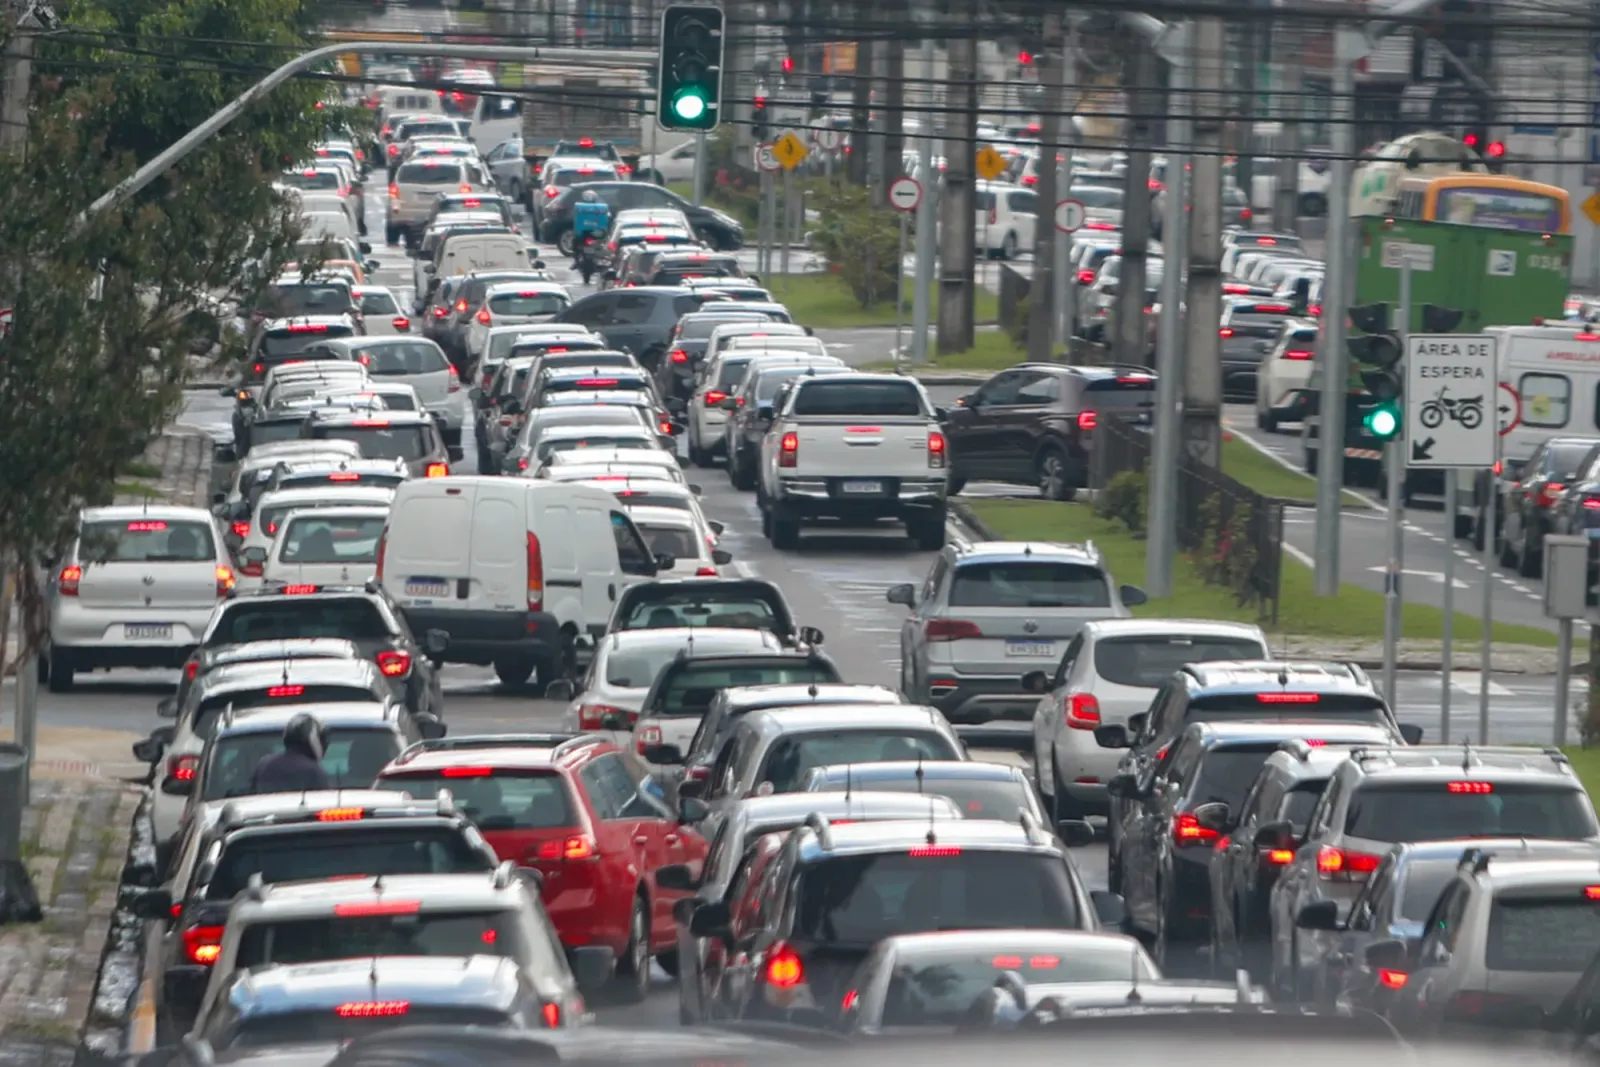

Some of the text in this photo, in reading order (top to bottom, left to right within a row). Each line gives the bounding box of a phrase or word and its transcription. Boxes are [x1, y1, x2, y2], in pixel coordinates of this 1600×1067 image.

[1417, 340, 1489, 356] ÁREA DE
[1420, 366, 1485, 378] ESPERA
